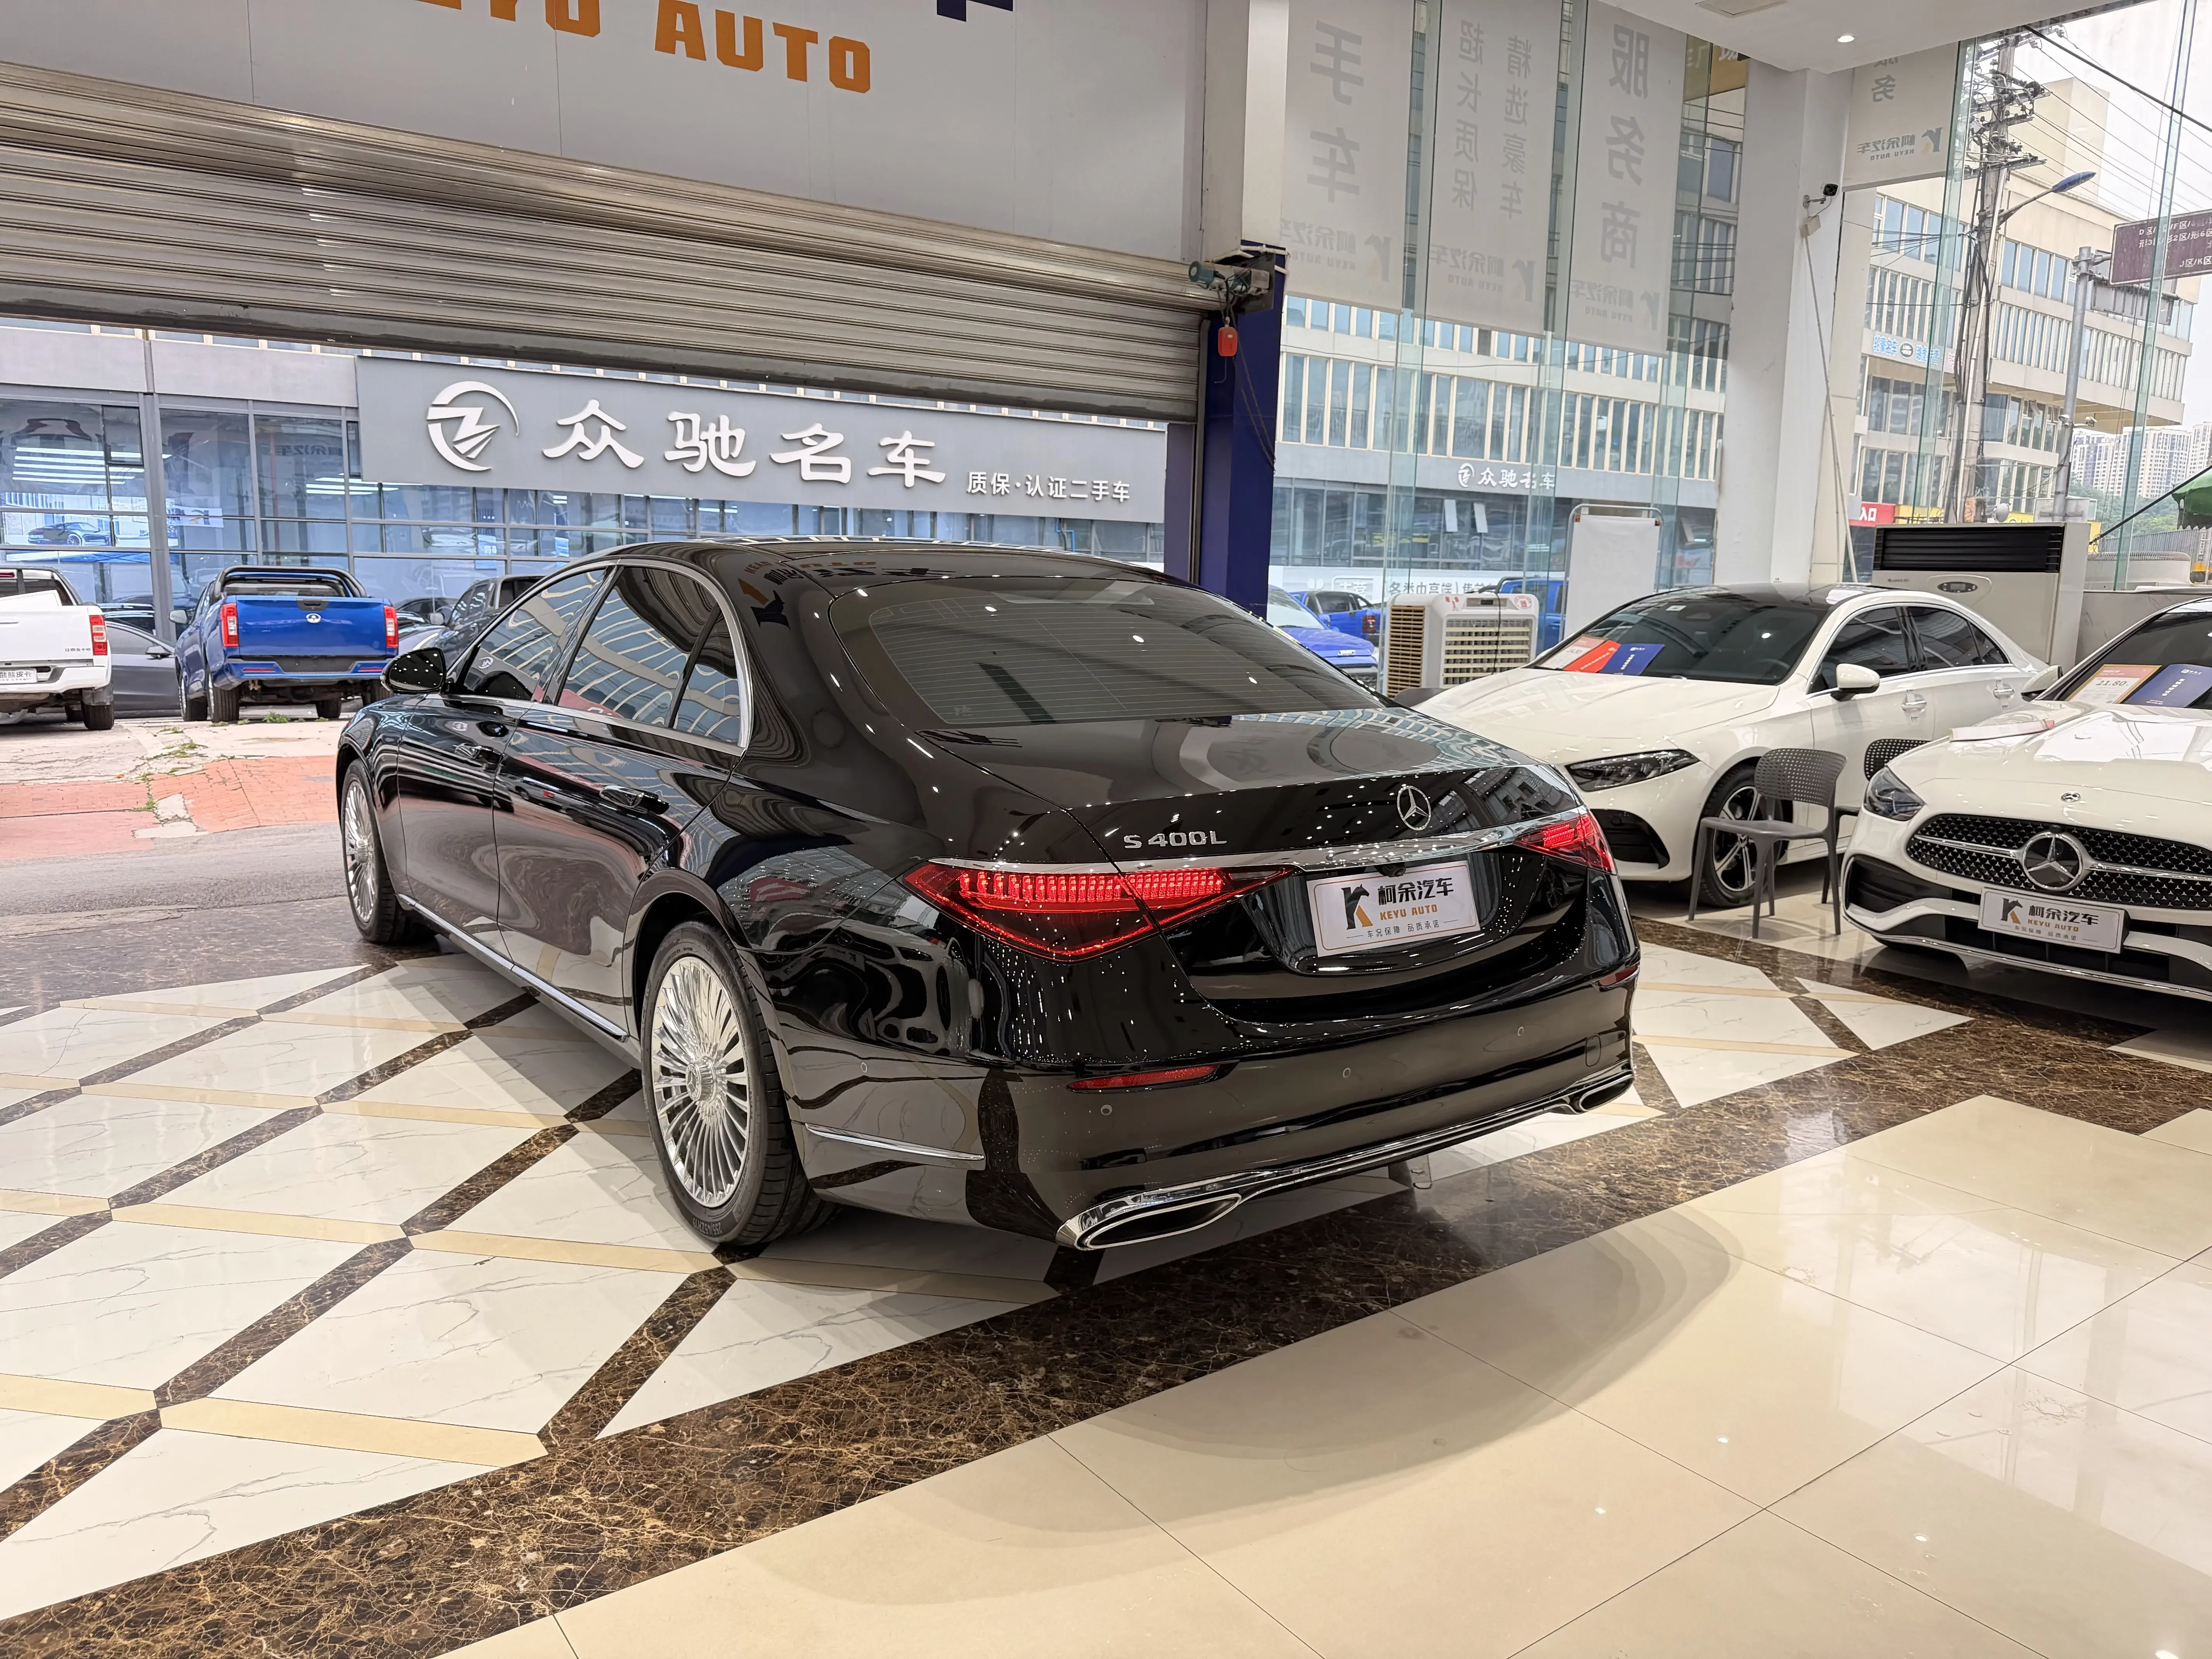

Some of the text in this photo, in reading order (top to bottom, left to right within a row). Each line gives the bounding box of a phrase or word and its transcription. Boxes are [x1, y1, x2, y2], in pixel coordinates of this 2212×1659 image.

[654, 0, 870, 93] AUTO
[543, 400, 946, 488] 众驰名车
[1477, 467, 1556, 490] 众驰名车
[1859, 507, 1877, 522] 入口
[1124, 831, 1227, 848] S 400L
[1377, 878, 1454, 905] 柯余汽车
[1380, 904, 1438, 921] KEYU AUTO
[2028, 905, 2099, 925] 柯余汽车
[1367, 919, 1439, 938] 车况保障 品质承诺
[2028, 919, 2079, 932] KEYU AUTO
